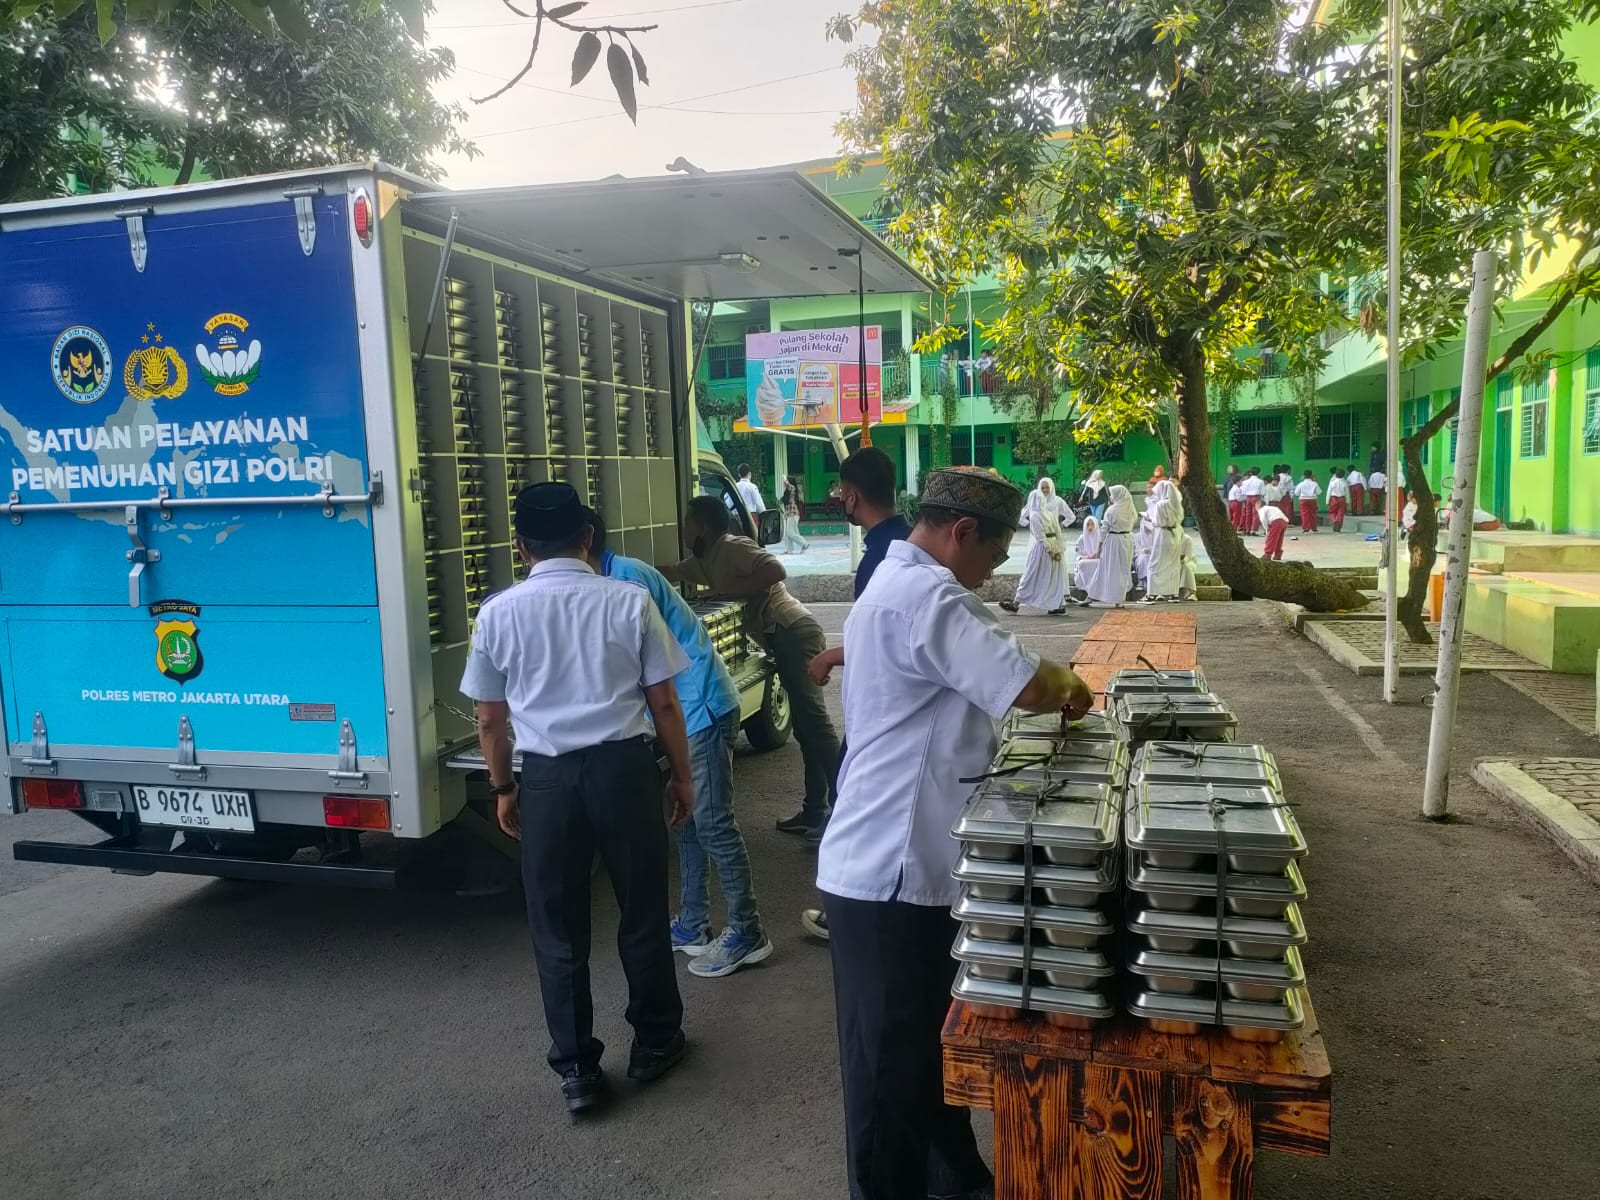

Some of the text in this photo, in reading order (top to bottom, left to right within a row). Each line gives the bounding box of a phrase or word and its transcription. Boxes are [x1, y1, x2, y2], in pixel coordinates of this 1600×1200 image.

[210, 315, 245, 327] YAYASAN
[54, 329, 106, 359] BADAN GIZI NASIONAL
[779, 332, 849, 346] Pulang Sekolah
[779, 342, 843, 355] Jajan di Mekdi
[768, 368, 795, 376] GRATIS
[56, 372, 109, 400] REPUBLIK INDONESIA
[26, 416, 309, 453] SATUAN PELAYANAN
[12, 456, 333, 490] PEMENUHAN GIZI POLRI
[152, 602, 197, 614] METRO JAYA
[81, 689, 290, 706] POLRES METRO JAKARTA UTARA
[137, 789, 249, 817] B 9674 UXH
